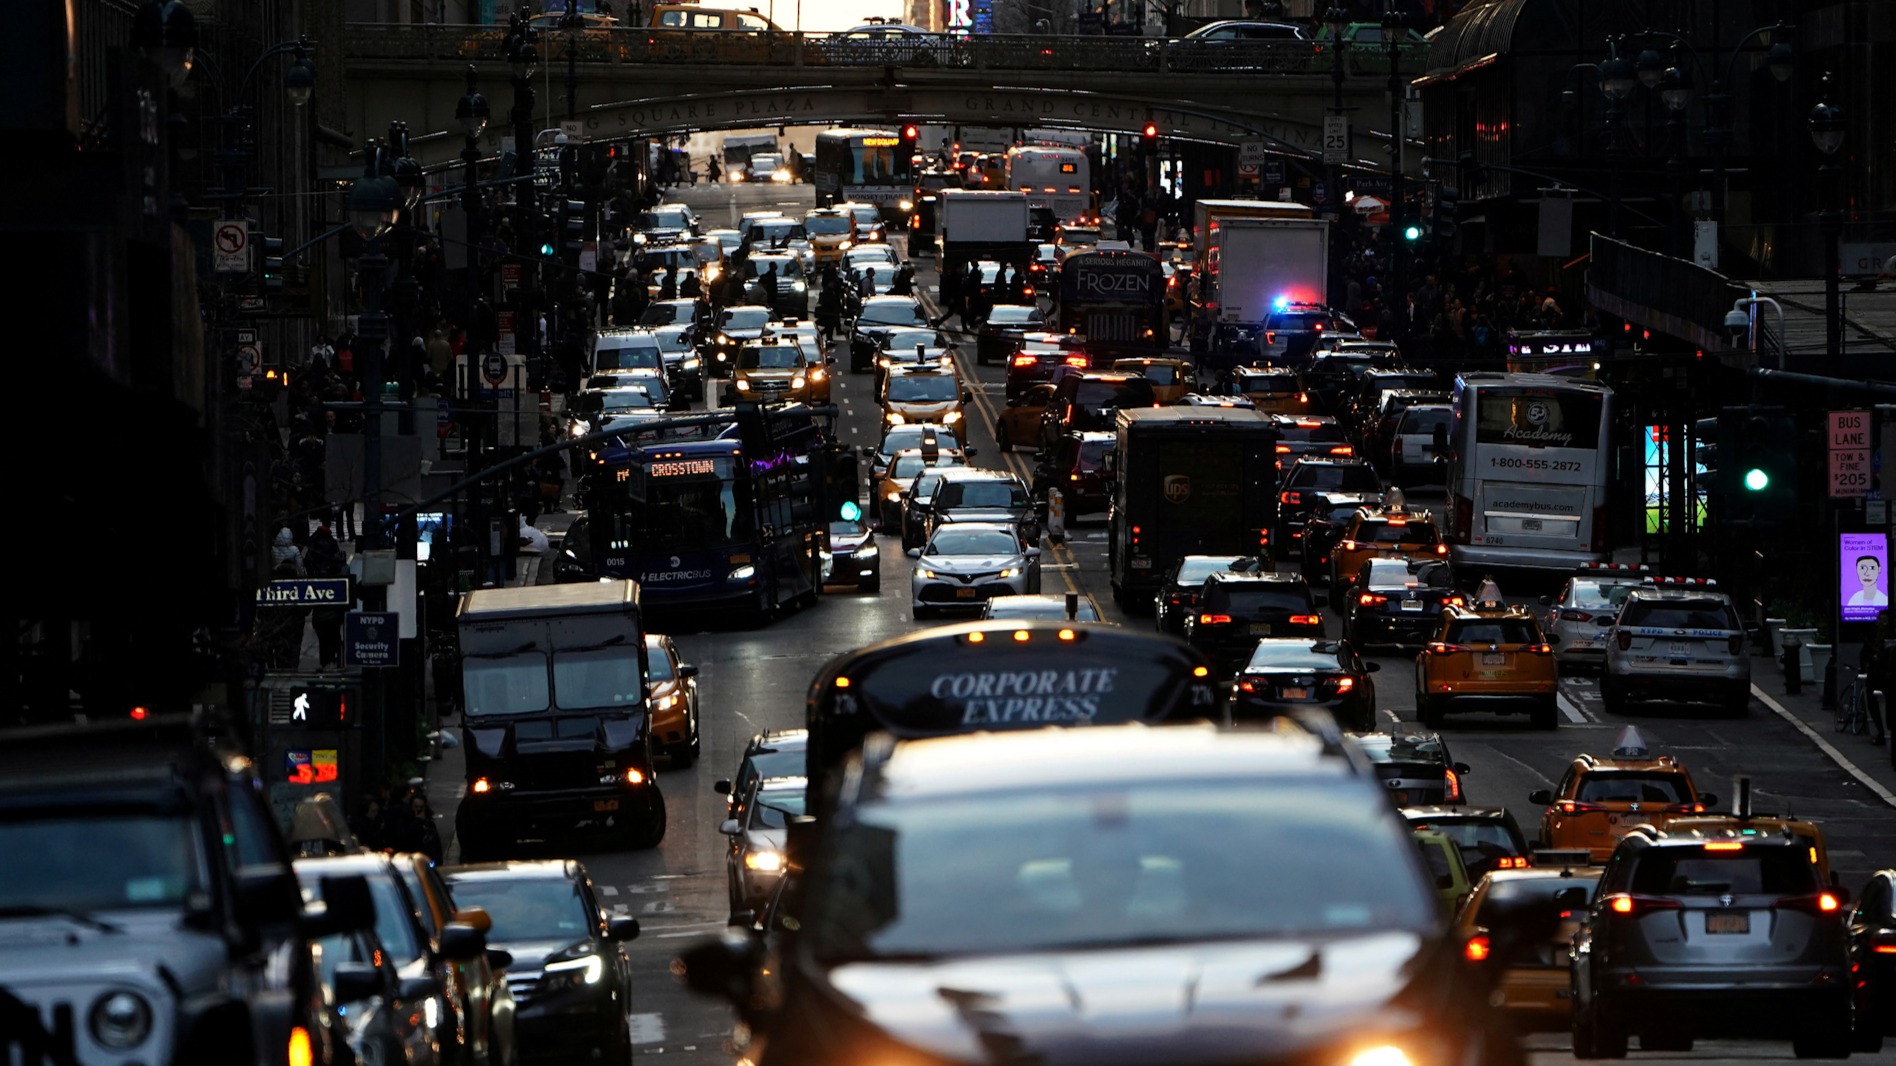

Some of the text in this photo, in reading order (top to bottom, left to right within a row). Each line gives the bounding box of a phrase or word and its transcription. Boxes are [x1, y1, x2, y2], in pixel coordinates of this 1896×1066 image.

[618, 98, 814, 126] SQUARE PLAZA
[966, 98, 1054, 114] GRAND
[1326, 135, 1345, 148] 25
[1085, 258, 1114, 266] SERIOUS
[1076, 269, 1150, 294] FROZEN
[1838, 417, 1861, 429] BUS
[1503, 424, 1574, 446] Academy
[1835, 433, 1864, 445] LANE
[1835, 453, 1865, 461] TOW &
[651, 460, 714, 477] CROSSTOWN
[1490, 457, 1582, 472] 1-800-555-2872
[1840, 462, 1860, 471] FINE
[1834, 473, 1866, 485] $205
[1166, 483, 1189, 500] ups
[1492, 499, 1574, 512] academybus.com
[606, 558, 625, 566] 0015
[304, 584, 335, 600] Ave
[360, 617, 385, 625] NYPD
[354, 641, 389, 652] Security
[355, 650, 389, 659] Camera
[930, 668, 1119, 700] CORPORATE
[961, 694, 1101, 726] EXPRESS
